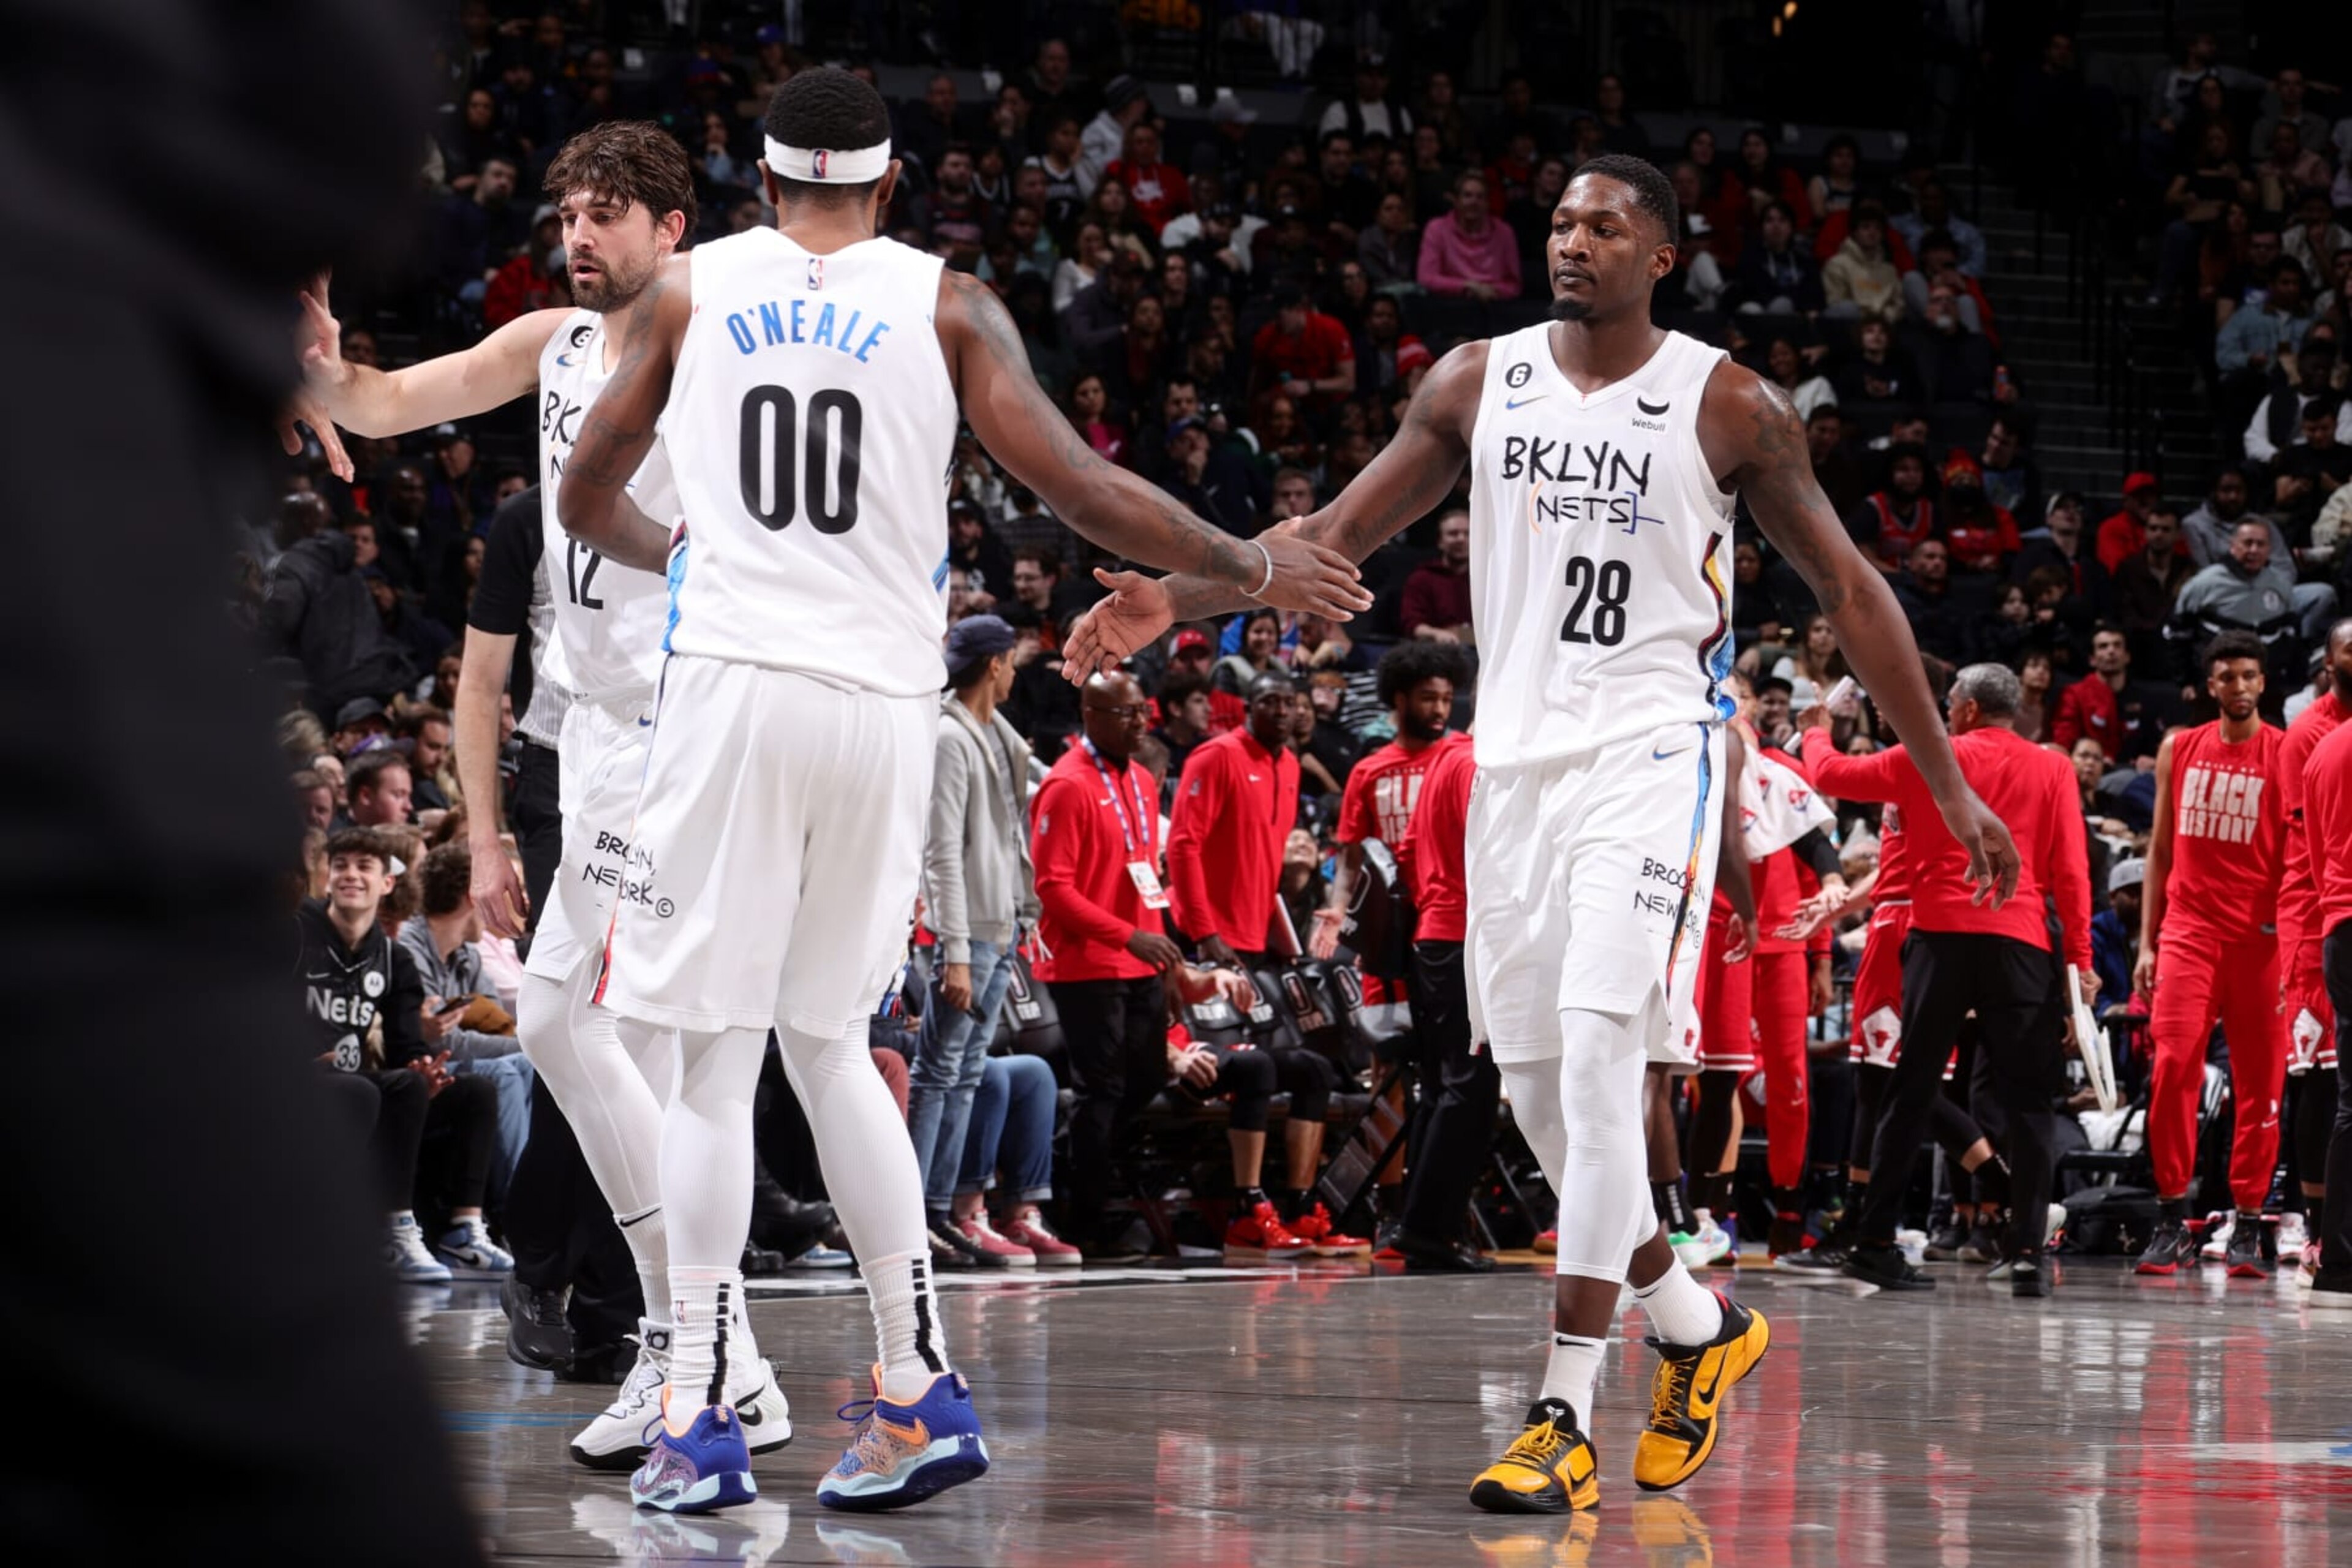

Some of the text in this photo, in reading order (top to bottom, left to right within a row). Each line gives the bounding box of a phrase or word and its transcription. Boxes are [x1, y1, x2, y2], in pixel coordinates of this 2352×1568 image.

[726, 300, 890, 363] O'NEALE
[1632, 418, 1665, 432] Webull
[740, 384, 862, 534] 00
[1502, 436, 1651, 496] BKLYN
[1561, 556, 1630, 646] 28
[2180, 767, 2264, 818] BLACK
[307, 986, 375, 1027] Nets
